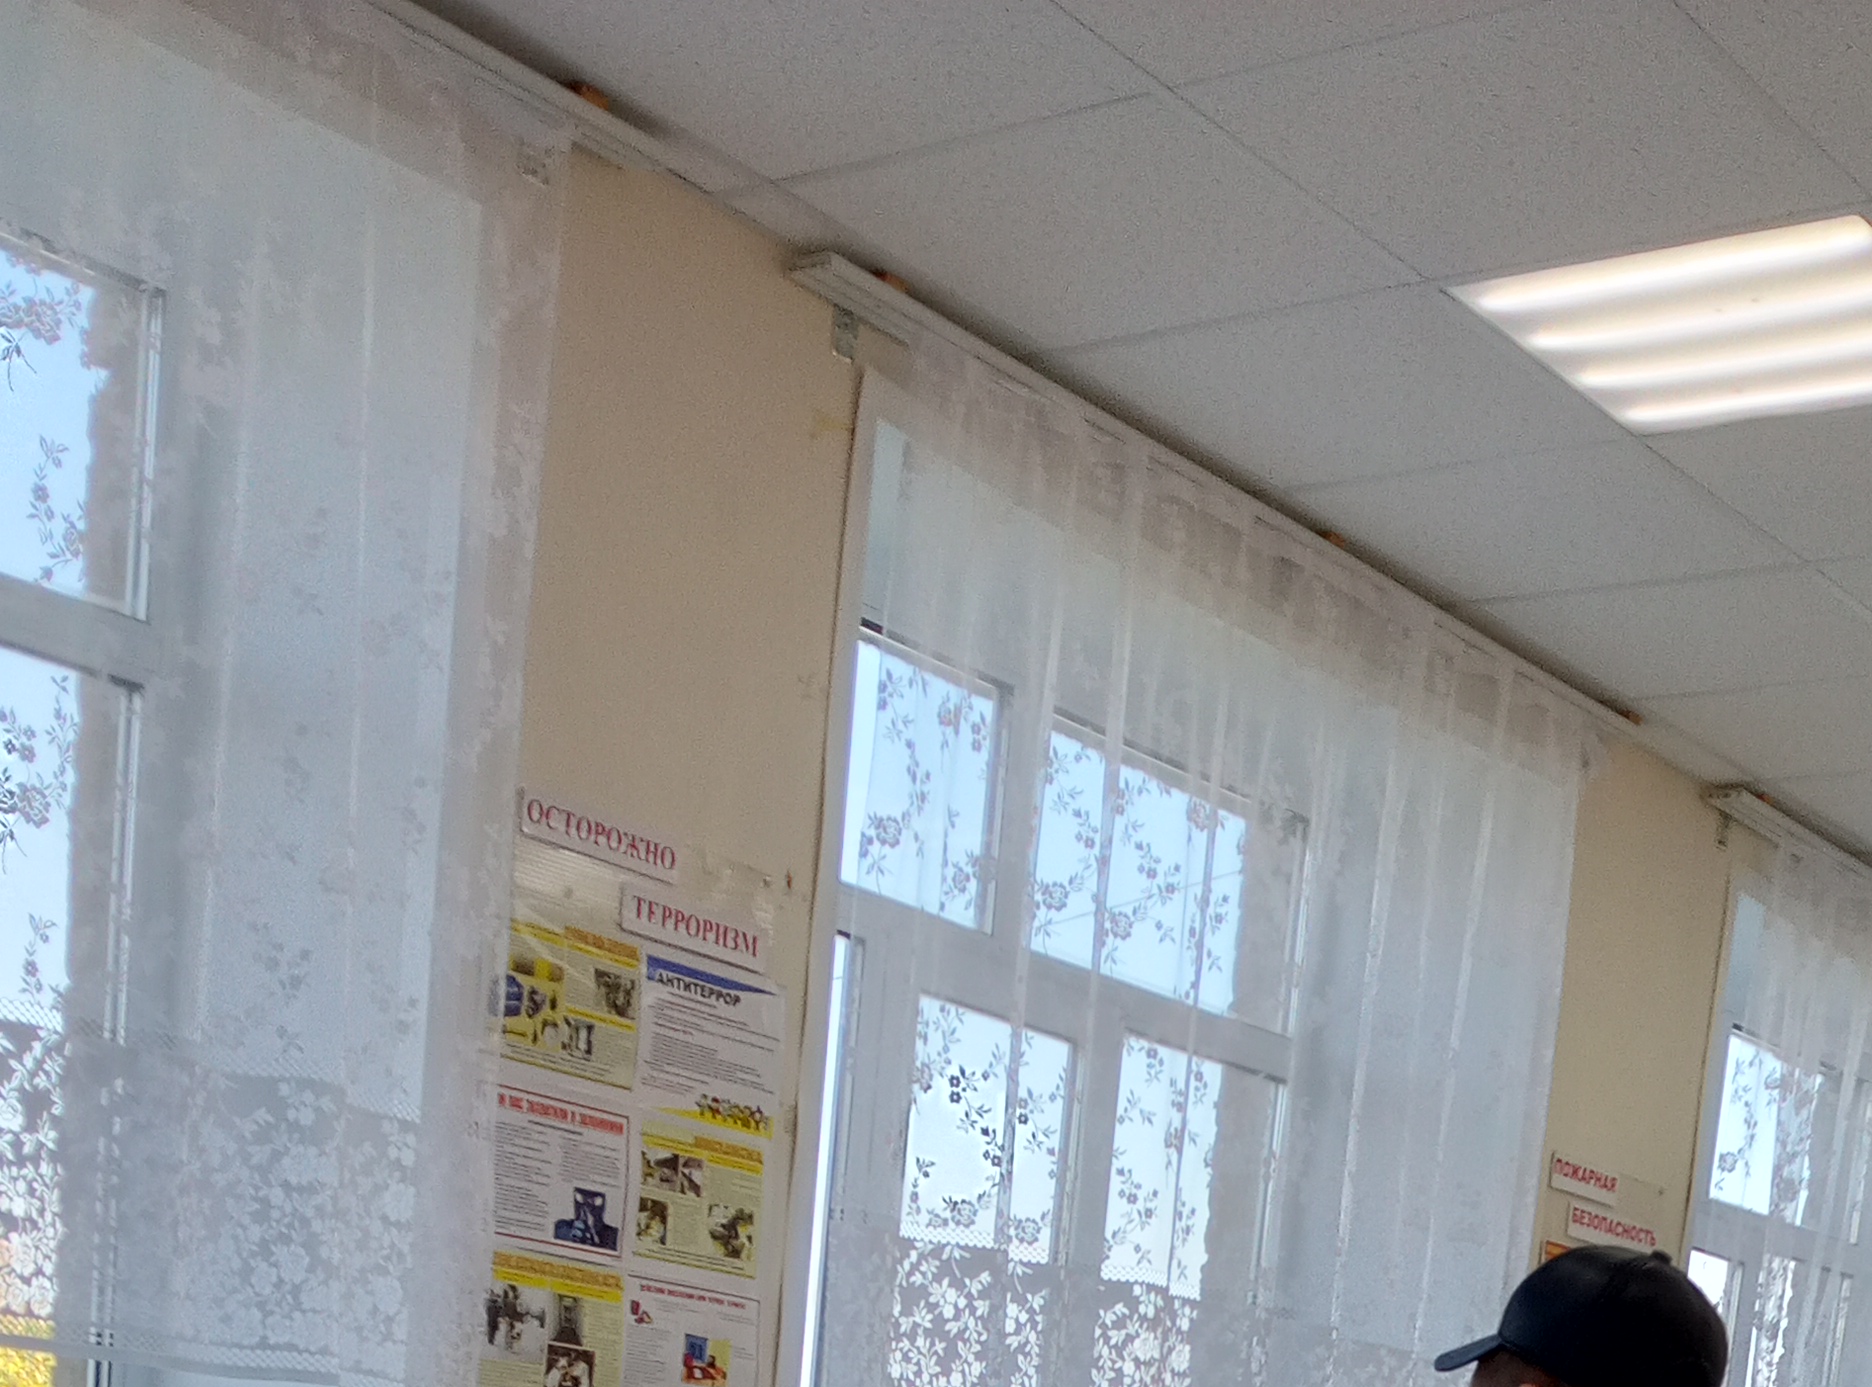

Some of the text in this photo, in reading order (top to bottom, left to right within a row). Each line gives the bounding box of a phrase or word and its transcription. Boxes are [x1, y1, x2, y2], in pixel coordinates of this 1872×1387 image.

[527, 799, 676, 870] ОСТОРОЖНО
[633, 895, 758, 958] ТЕРРОРИЗМ
[656, 972, 741, 1007] АНТИТЕРРОР
[1555, 1158, 1618, 1193] ПОЖАРНАЯ
[1572, 1206, 1656, 1247] БЕЗОПАСНОСТЬ
